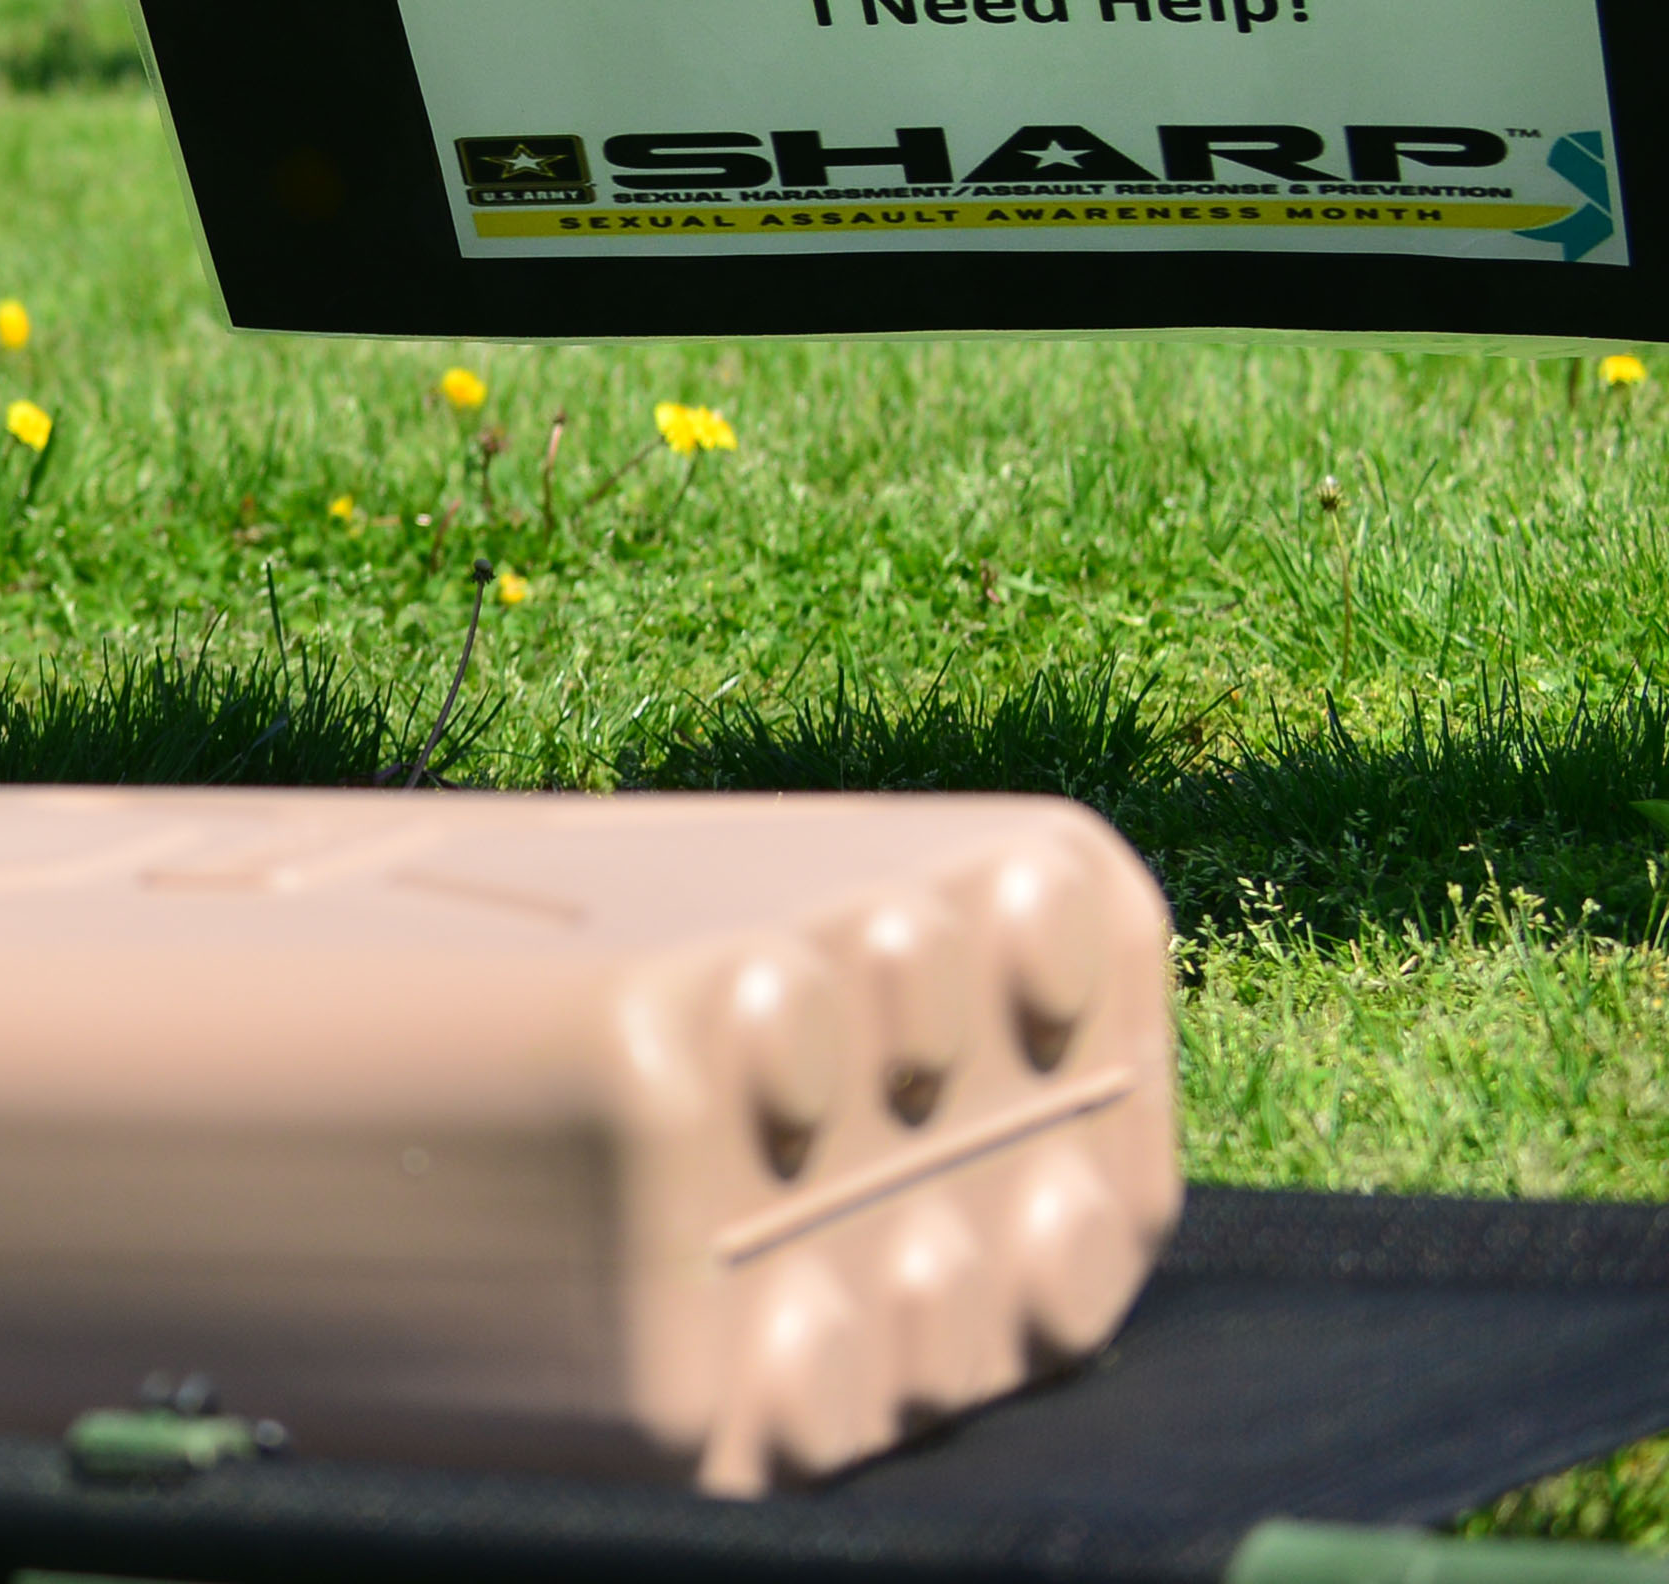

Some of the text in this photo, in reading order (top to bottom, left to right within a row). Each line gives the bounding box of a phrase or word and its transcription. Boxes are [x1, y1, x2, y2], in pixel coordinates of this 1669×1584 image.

[602, 124, 1508, 190] SHARP
[612, 190, 732, 204] SEXUAL
[1114, 183, 1280, 196] RESPONSE
[1288, 184, 1310, 195] &
[1318, 184, 1515, 199] PREVENTION
[559, 206, 1443, 230] SEXUAL ASSAULT AWARENESS MONTH
